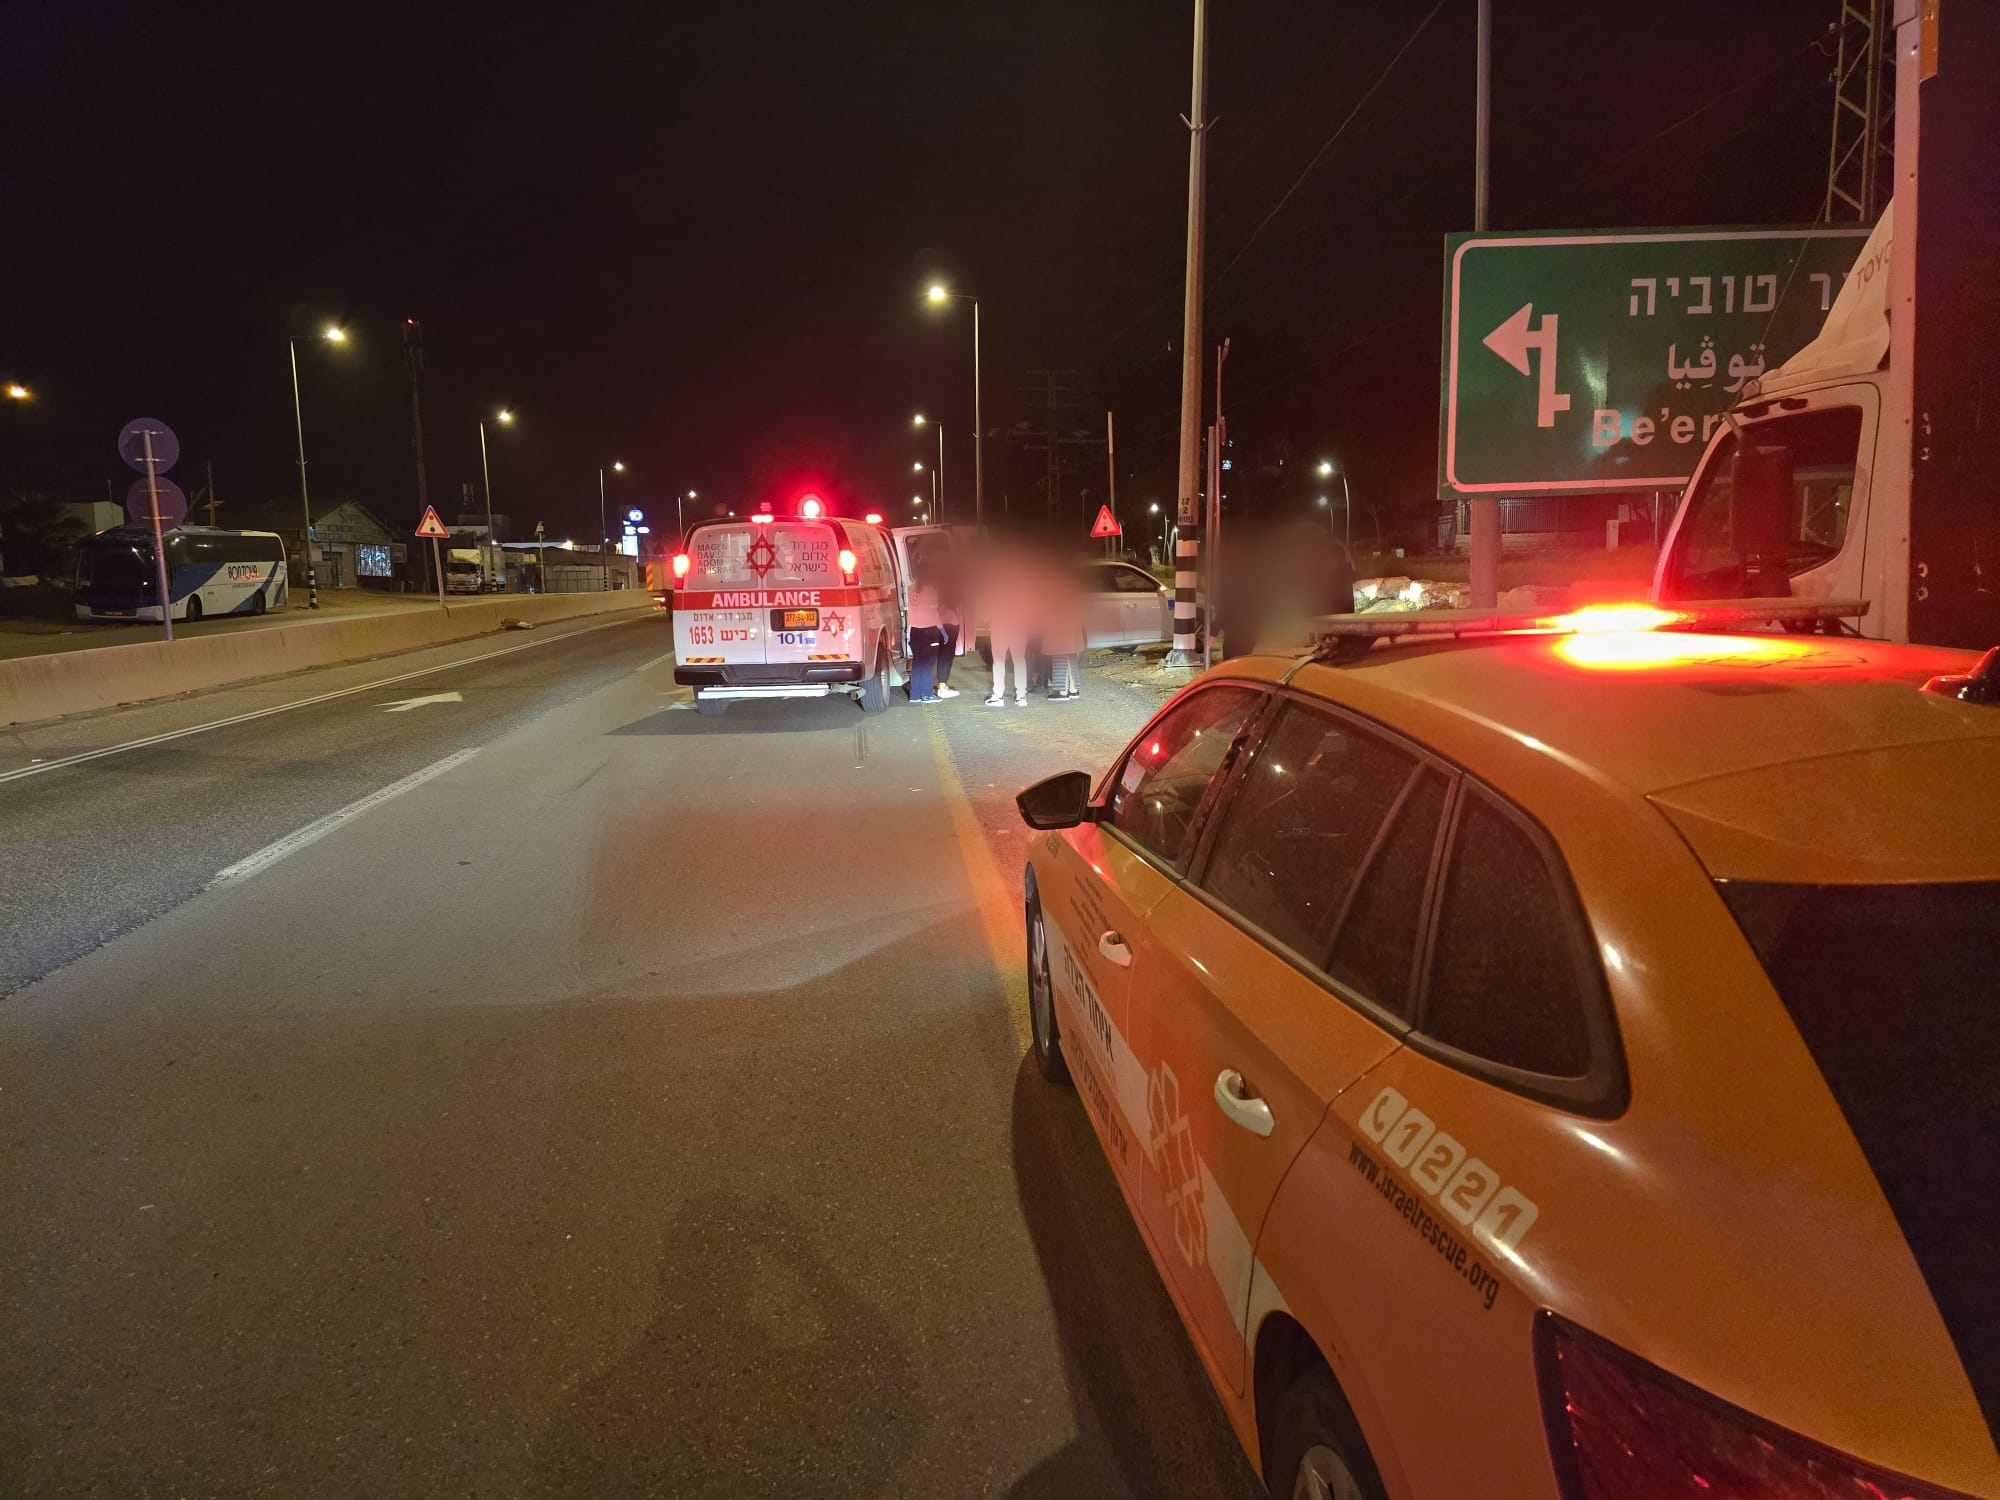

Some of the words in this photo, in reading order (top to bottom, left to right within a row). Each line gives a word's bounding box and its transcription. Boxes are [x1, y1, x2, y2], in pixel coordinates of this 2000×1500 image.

[1629, 274, 1777, 316] טוביה
[697, 543, 728, 552] MAGEN
[790, 541, 808, 551] דוד
[810, 541, 829, 552] מגן
[697, 551, 723, 559] DAVID
[802, 551, 829, 561] אדום
[697, 559, 724, 567] ADOM
[786, 560, 828, 573] בישראל
[709, 565, 736, 575] ISRAEL
[711, 591, 821, 608] AMBULANCE
[693, 612, 714, 622] אדום
[689, 625, 714, 645] 1653
[776, 632, 803, 645] 101
[1086, 984, 1114, 1062] איחוד
[1393, 1116, 1527, 1247] 1221
[1350, 1142, 1499, 1310] www.israelrescue.org
